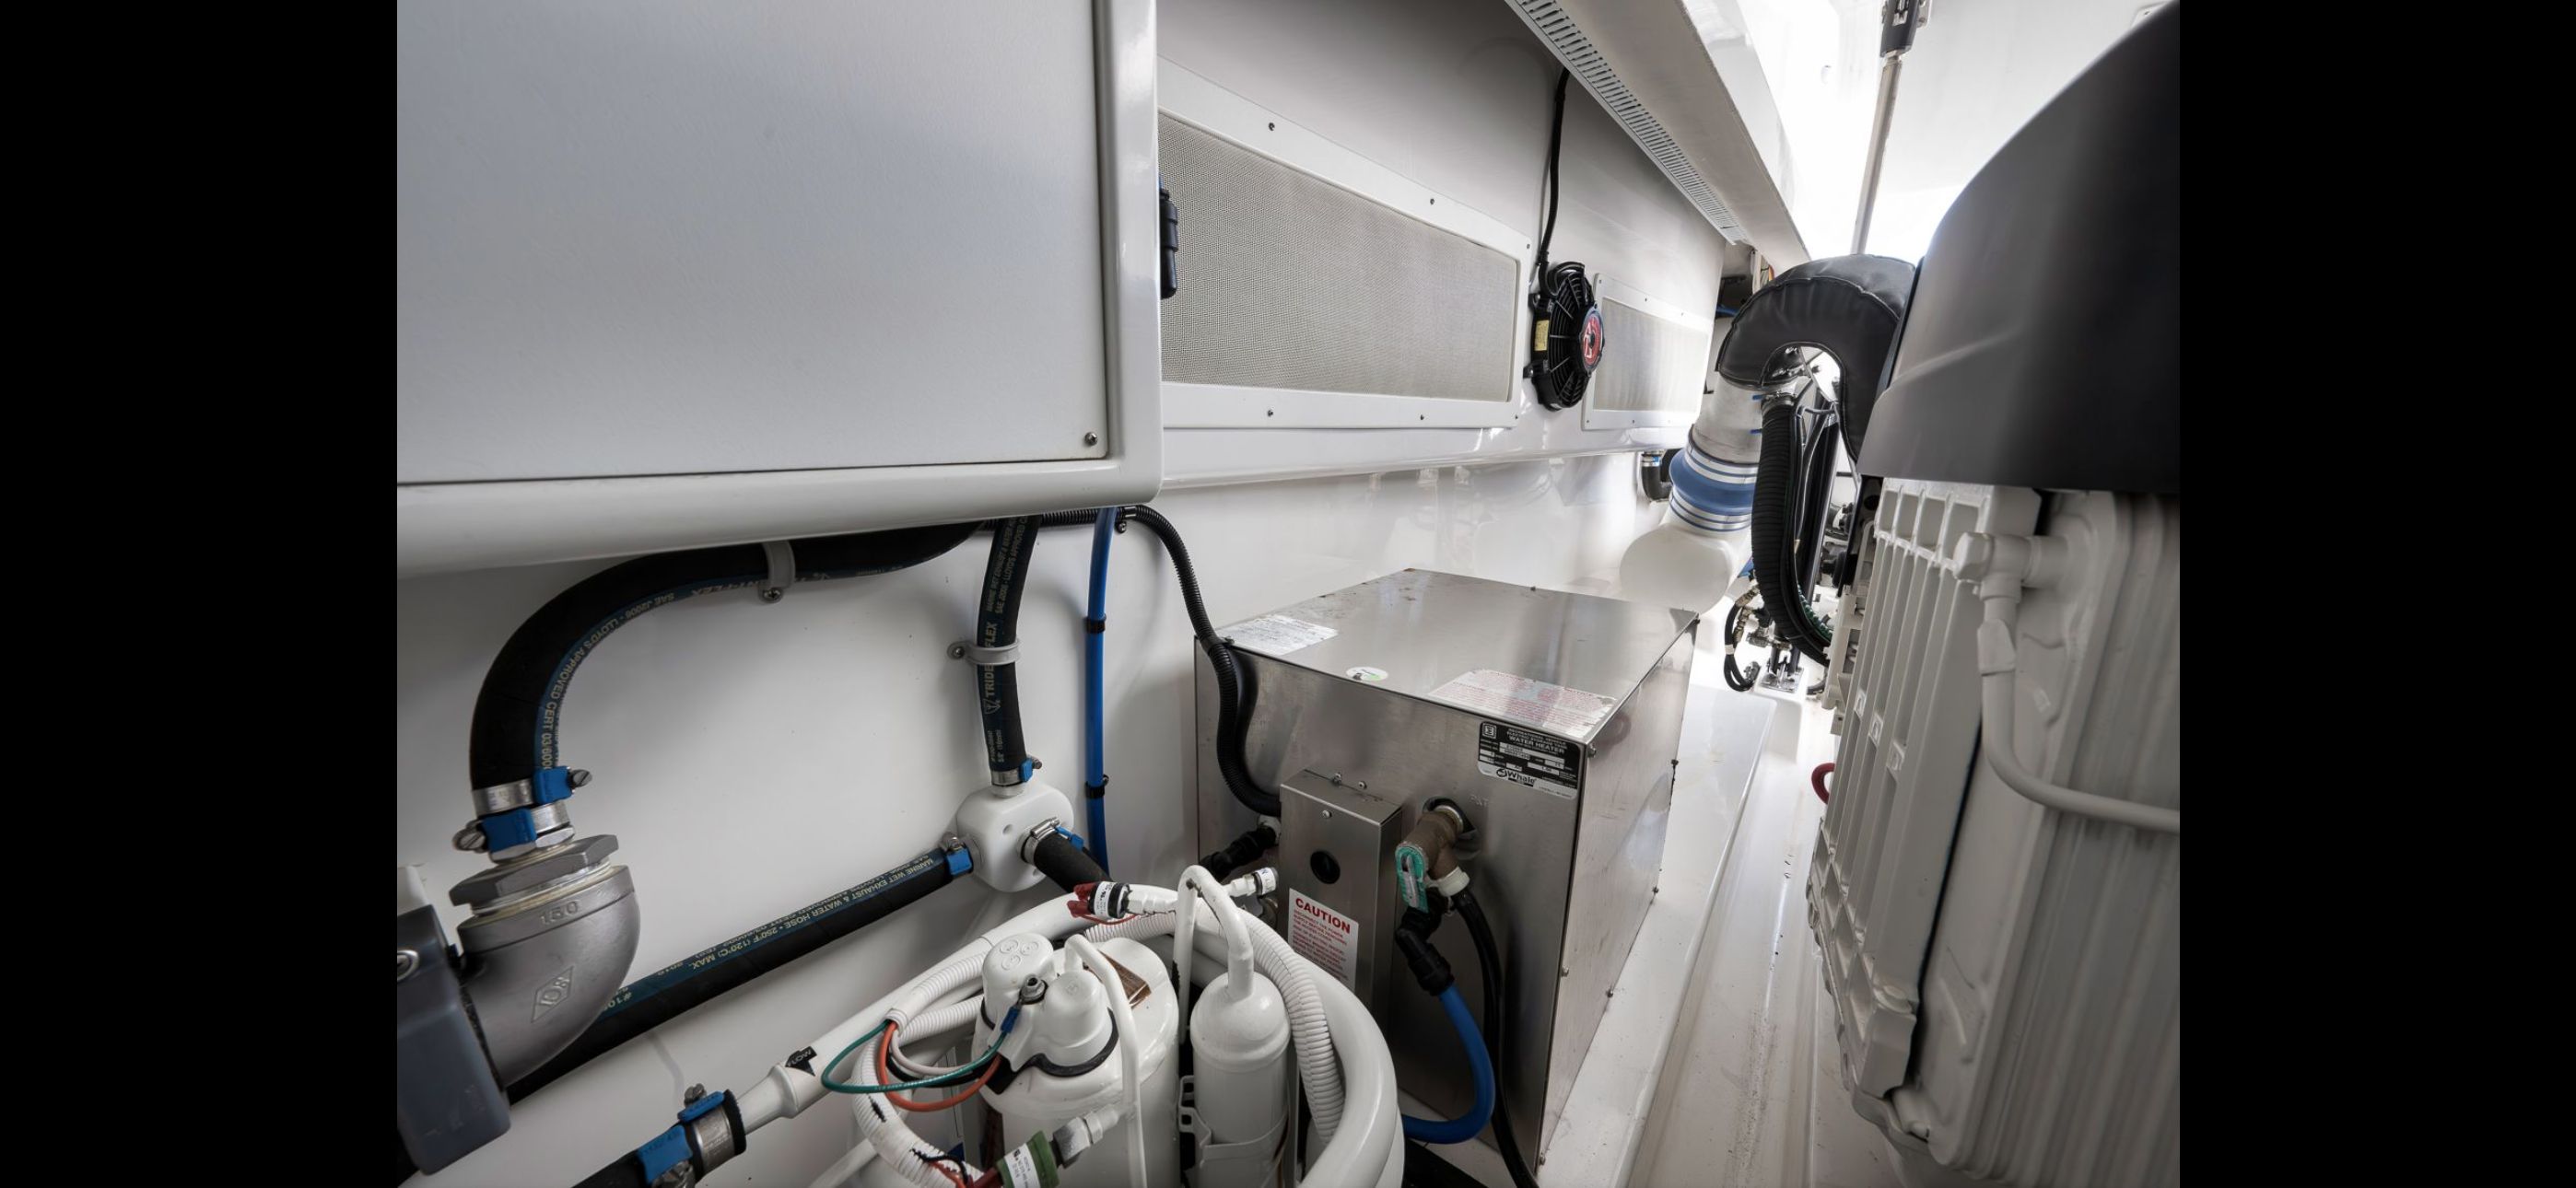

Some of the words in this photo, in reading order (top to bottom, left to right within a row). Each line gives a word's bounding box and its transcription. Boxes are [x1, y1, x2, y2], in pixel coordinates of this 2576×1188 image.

[1508, 736, 1533, 746] WATER
[1535, 742, 1564, 753] HEATER
[905, 857, 933, 875] MARINE
[887, 870, 905, 883] WET
[850, 879, 886, 899] EXHAUST
[811, 899, 841, 916] WATER
[1295, 898, 1351, 934] CAUTION
[784, 913, 810, 928] HOSE
